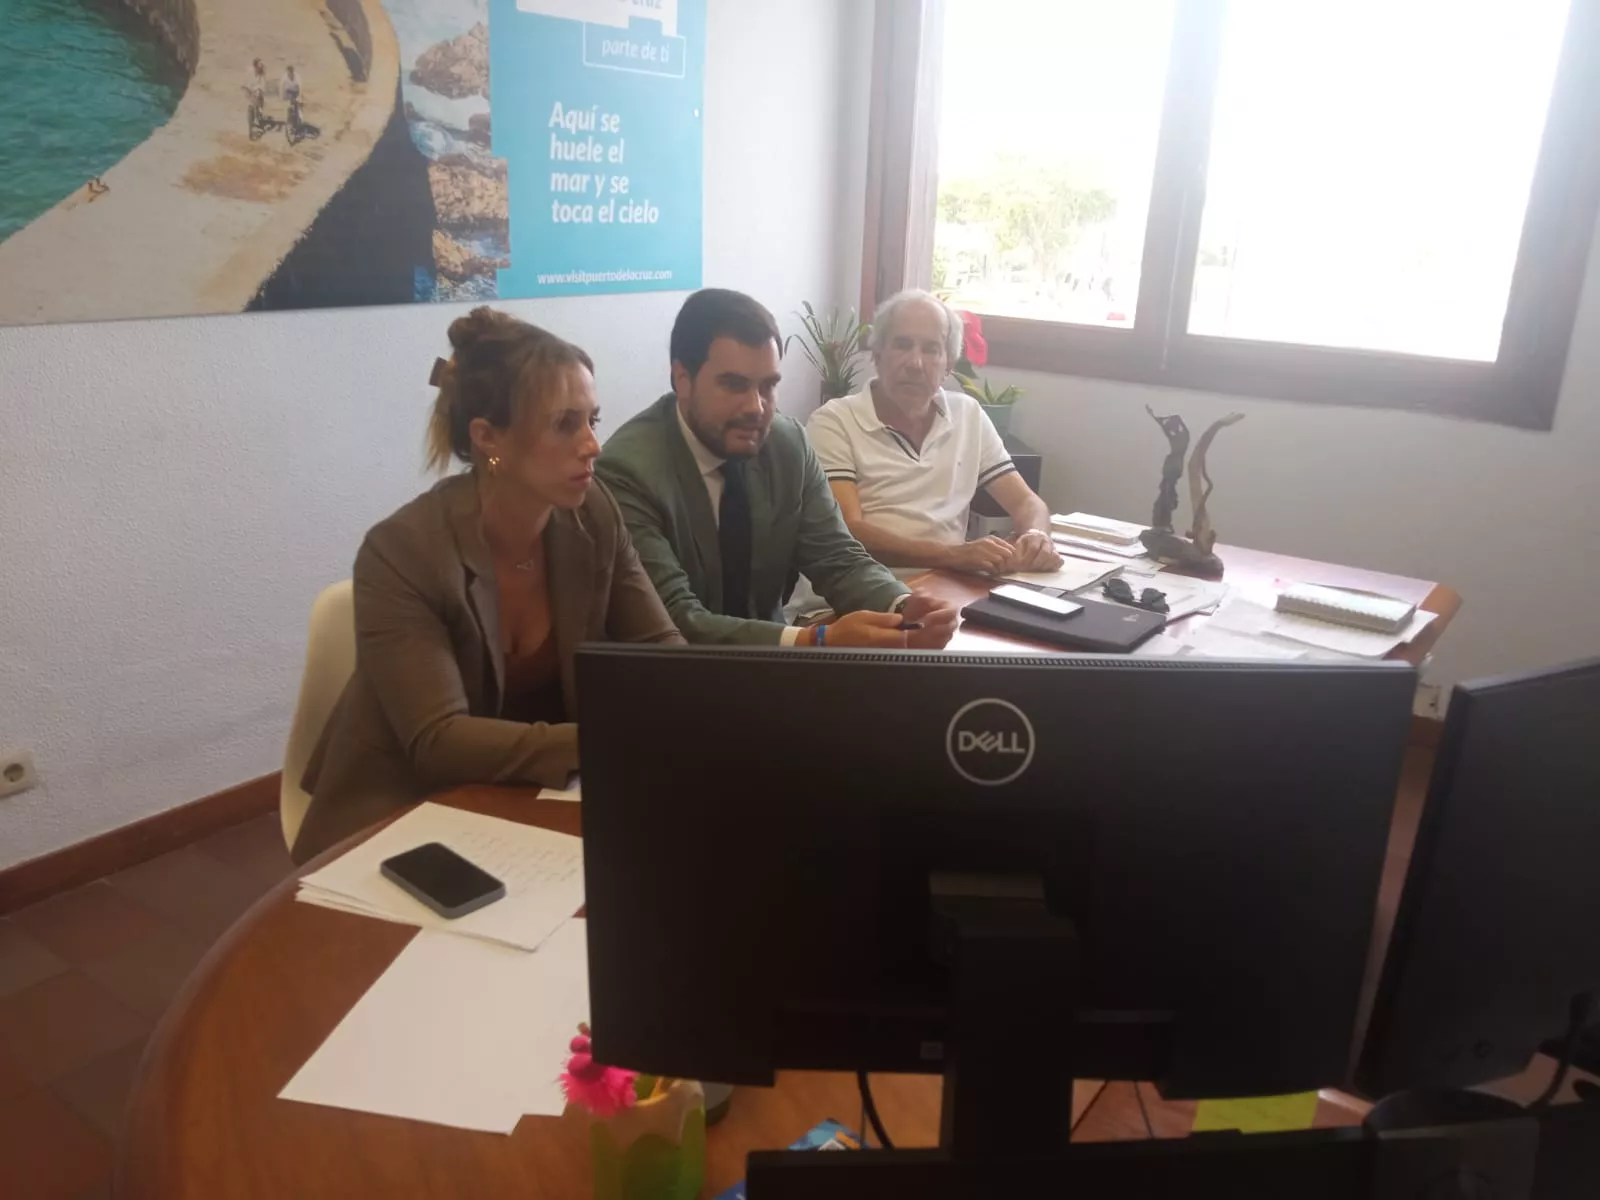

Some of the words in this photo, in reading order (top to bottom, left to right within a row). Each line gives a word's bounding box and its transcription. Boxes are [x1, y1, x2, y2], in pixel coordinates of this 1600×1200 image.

[602, 39, 640, 58] parte
[641, 41, 656, 60] de
[661, 42, 670, 63] ti
[548, 101, 599, 135] Aquí
[600, 112, 621, 134] se
[550, 132, 603, 163] huele
[608, 137, 625, 164] el
[551, 172, 590, 193] mar
[594, 173, 606, 199] y
[610, 175, 629, 194] se
[552, 198, 594, 223] toca
[598, 198, 615, 223] el
[618, 198, 659, 224] cielo
[537, 268, 673, 285] www.visitpuertodelacruz.com
[958, 730, 1025, 753] DELL
